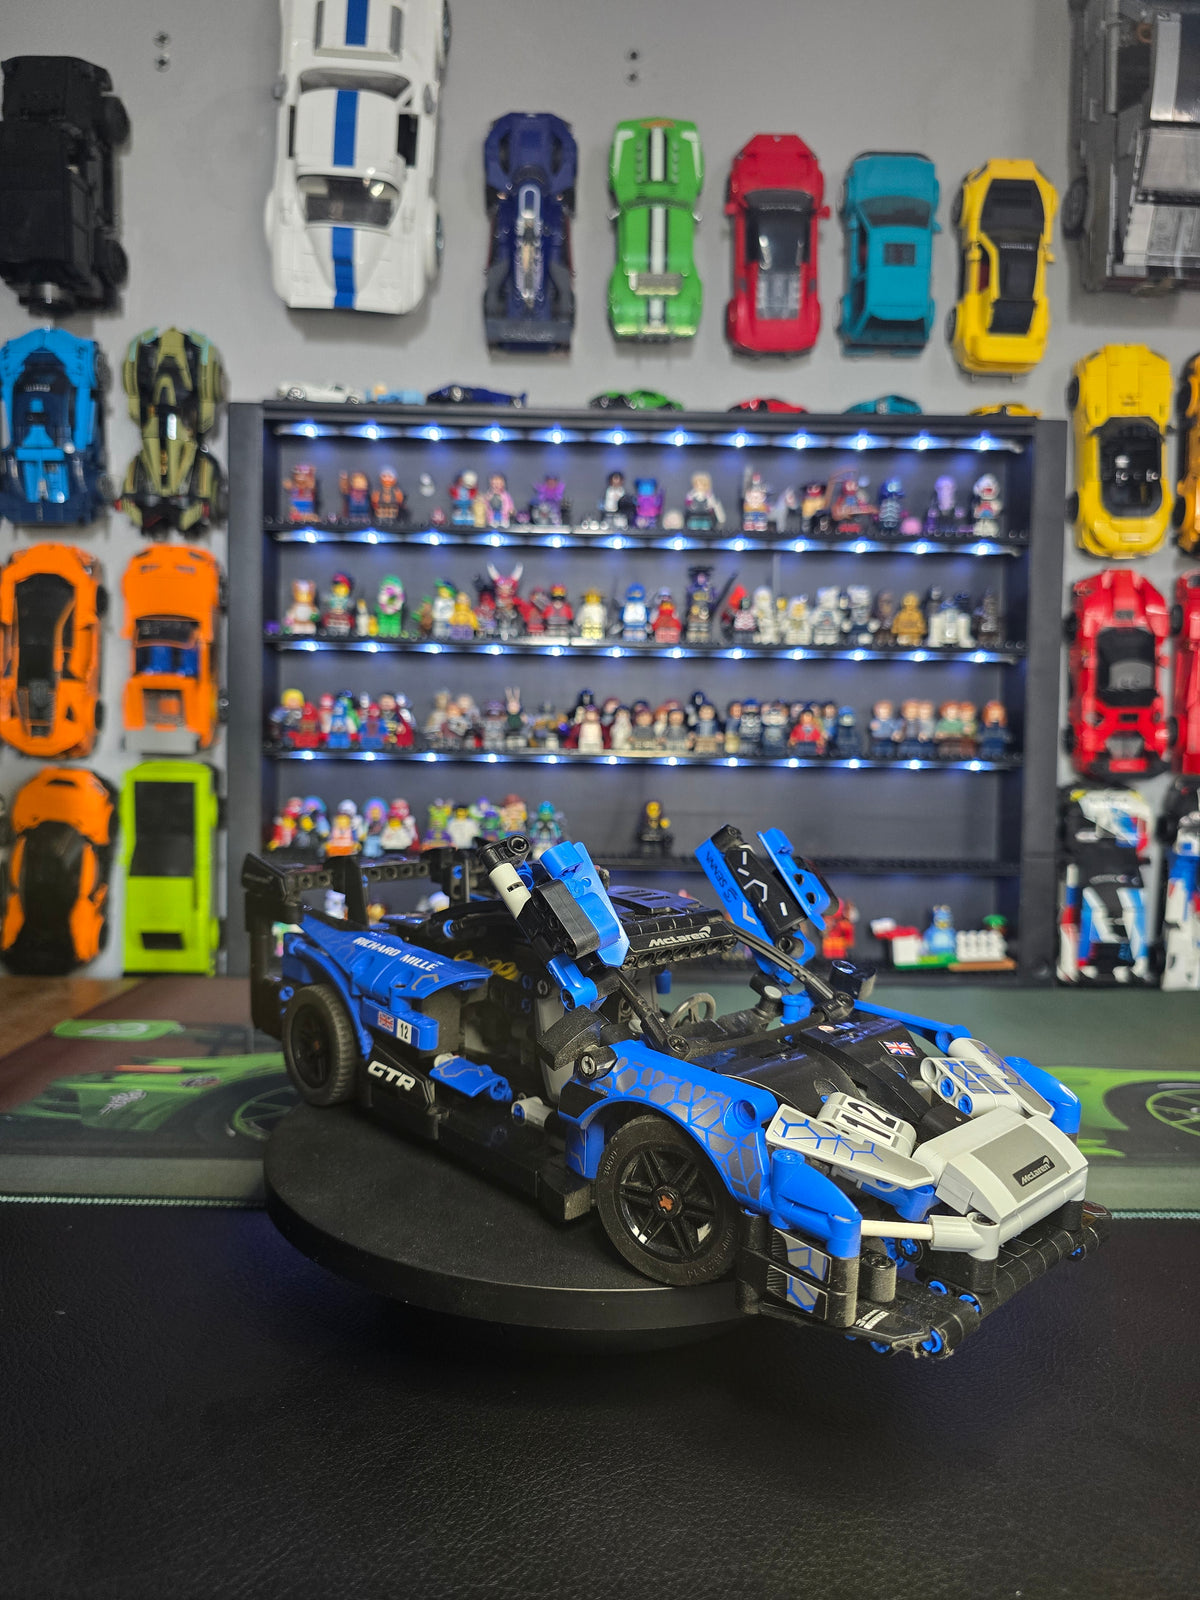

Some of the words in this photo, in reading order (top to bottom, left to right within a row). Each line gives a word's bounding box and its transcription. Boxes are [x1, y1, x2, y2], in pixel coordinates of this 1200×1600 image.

[648, 930, 711, 948] McLaren
[352, 936, 402, 957] RICHARD
[399, 953, 439, 972] MILLE
[400, 1022, 409, 1040] 12
[367, 1060, 416, 1092] GTR
[841, 1102, 897, 1140] 12
[1021, 1162, 1051, 1186] McLaren
